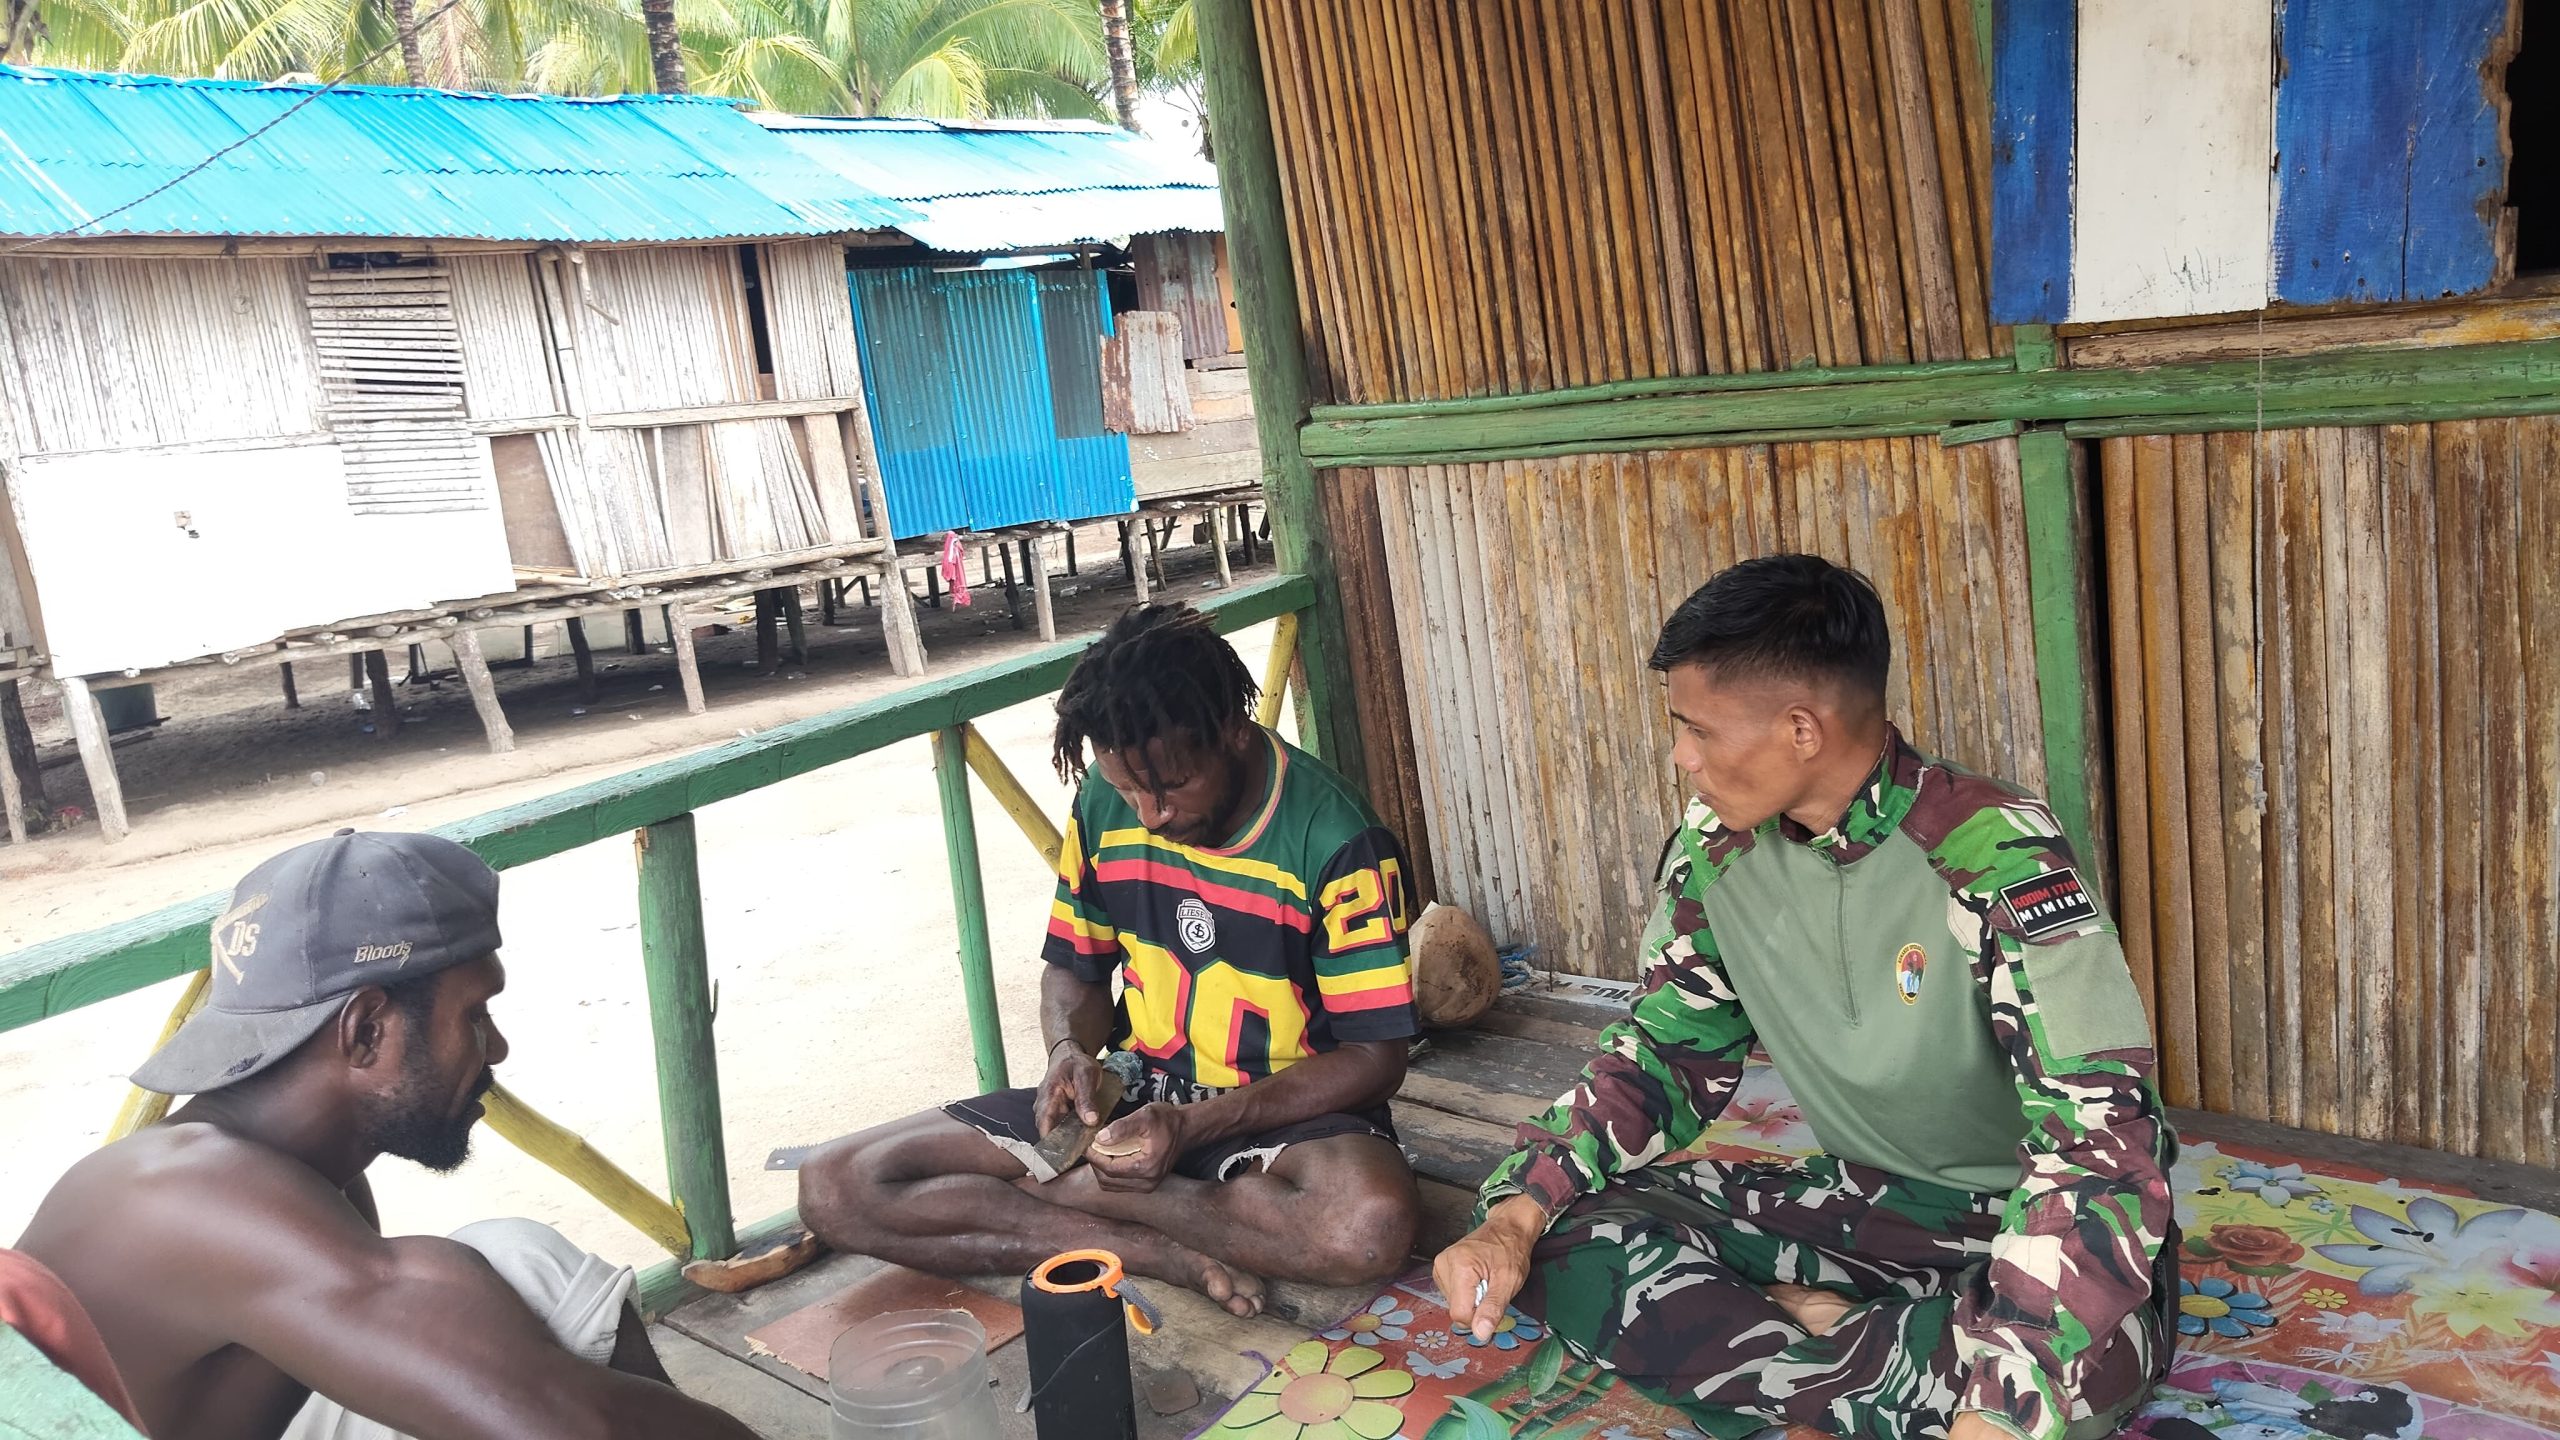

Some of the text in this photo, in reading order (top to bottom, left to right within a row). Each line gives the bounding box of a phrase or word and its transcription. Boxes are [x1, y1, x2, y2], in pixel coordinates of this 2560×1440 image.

[1319, 857, 1407, 954] 20
[2011, 888, 2051, 910] KODIM
[2018, 892, 2088, 923] MIMIKA
[353, 940, 414, 971] Bloods
